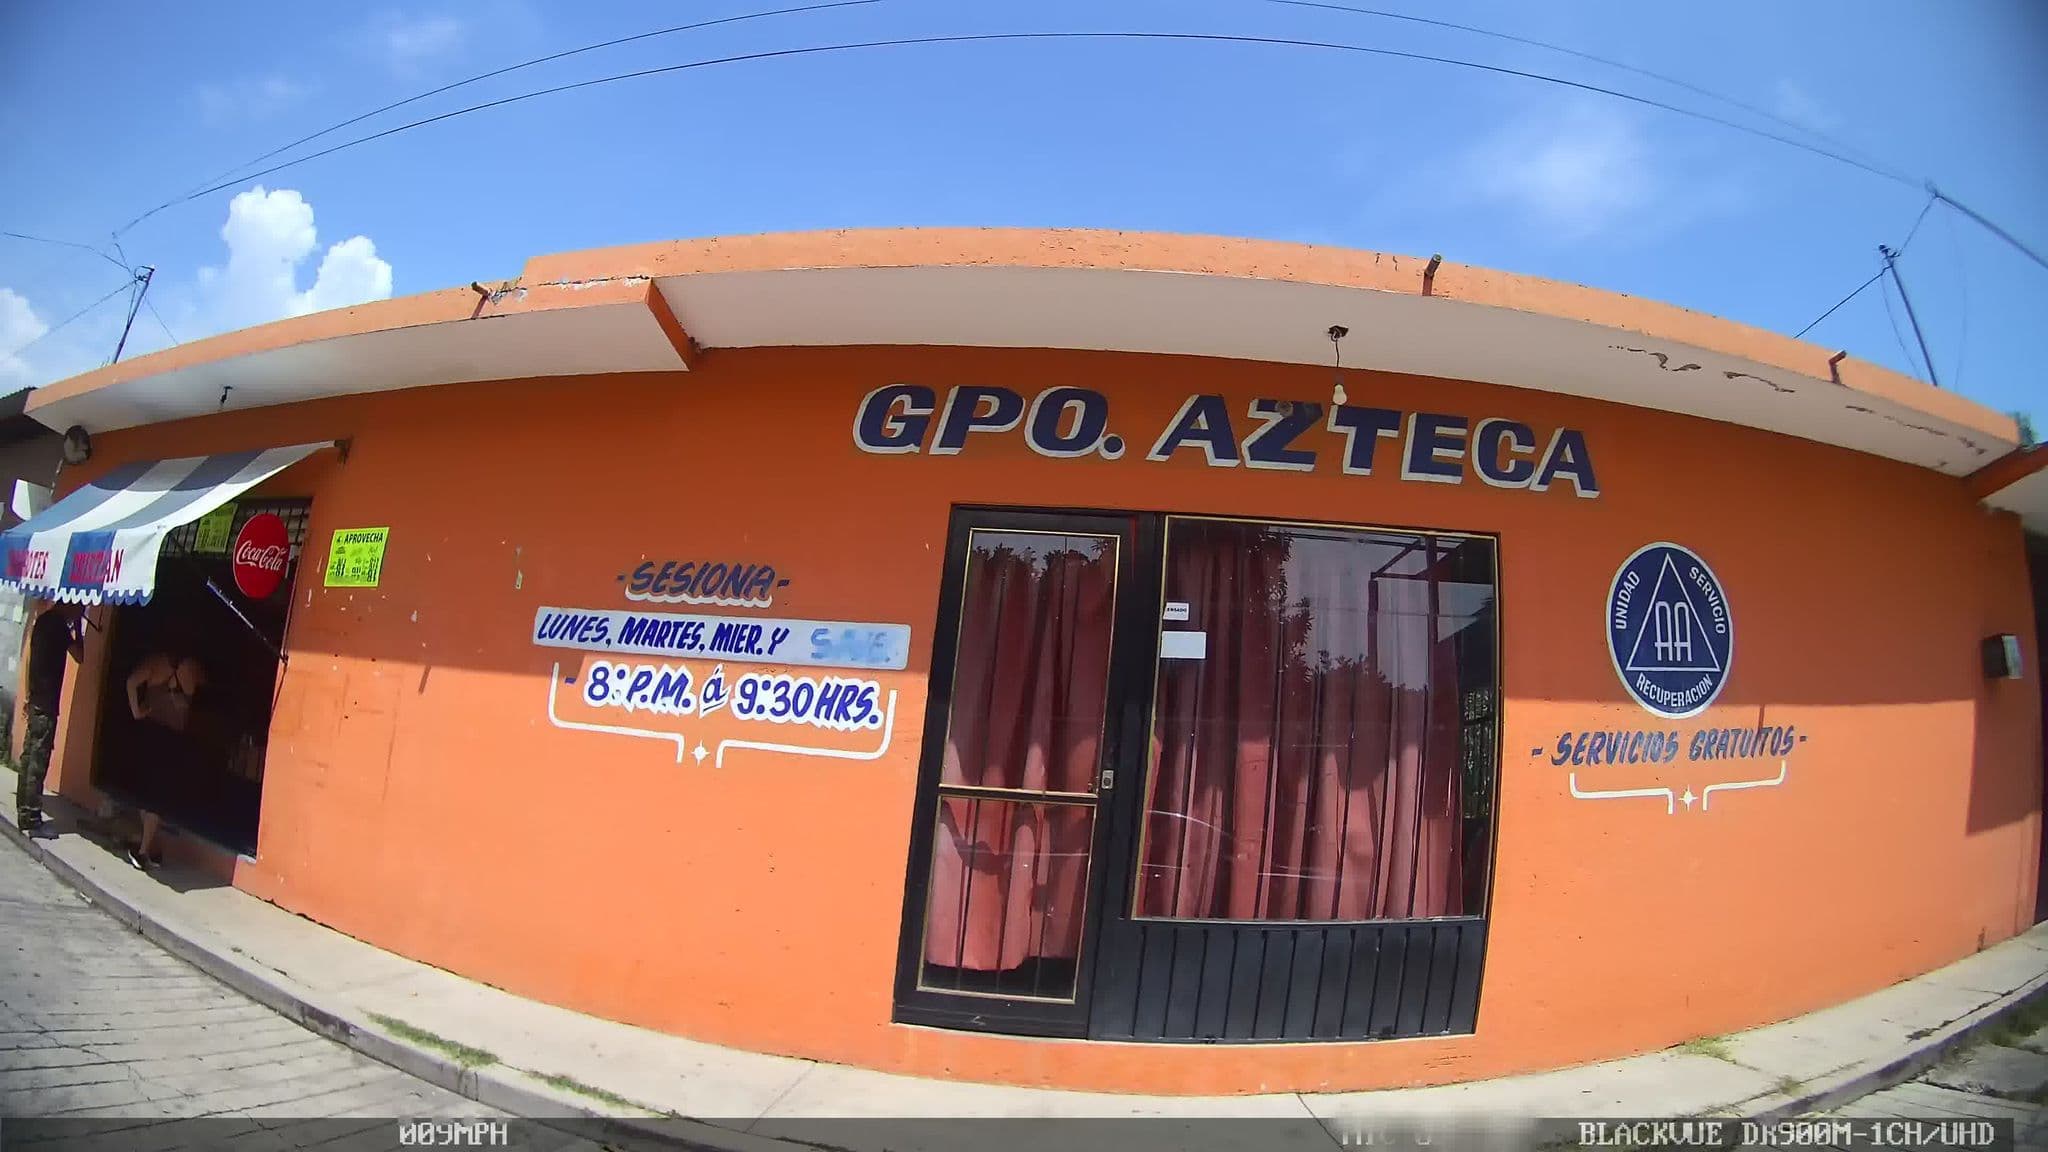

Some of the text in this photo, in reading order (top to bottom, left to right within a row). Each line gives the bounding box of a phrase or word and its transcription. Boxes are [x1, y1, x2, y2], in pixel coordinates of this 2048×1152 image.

[852, 384, 1600, 499] GPO. AZTECA
[344, 532, 383, 545] APROVECHA
[1615, 570, 1640, 630] UNIDAD
[1688, 566, 1726, 635] SERVICIO
[537, 613, 612, 648] LUNES,
[709, 622, 763, 655] MIER.
[767, 627, 790, 656] Y
[1654, 600, 1693, 662] AA
[1636, 672, 1713, 707] RECUPERACION
